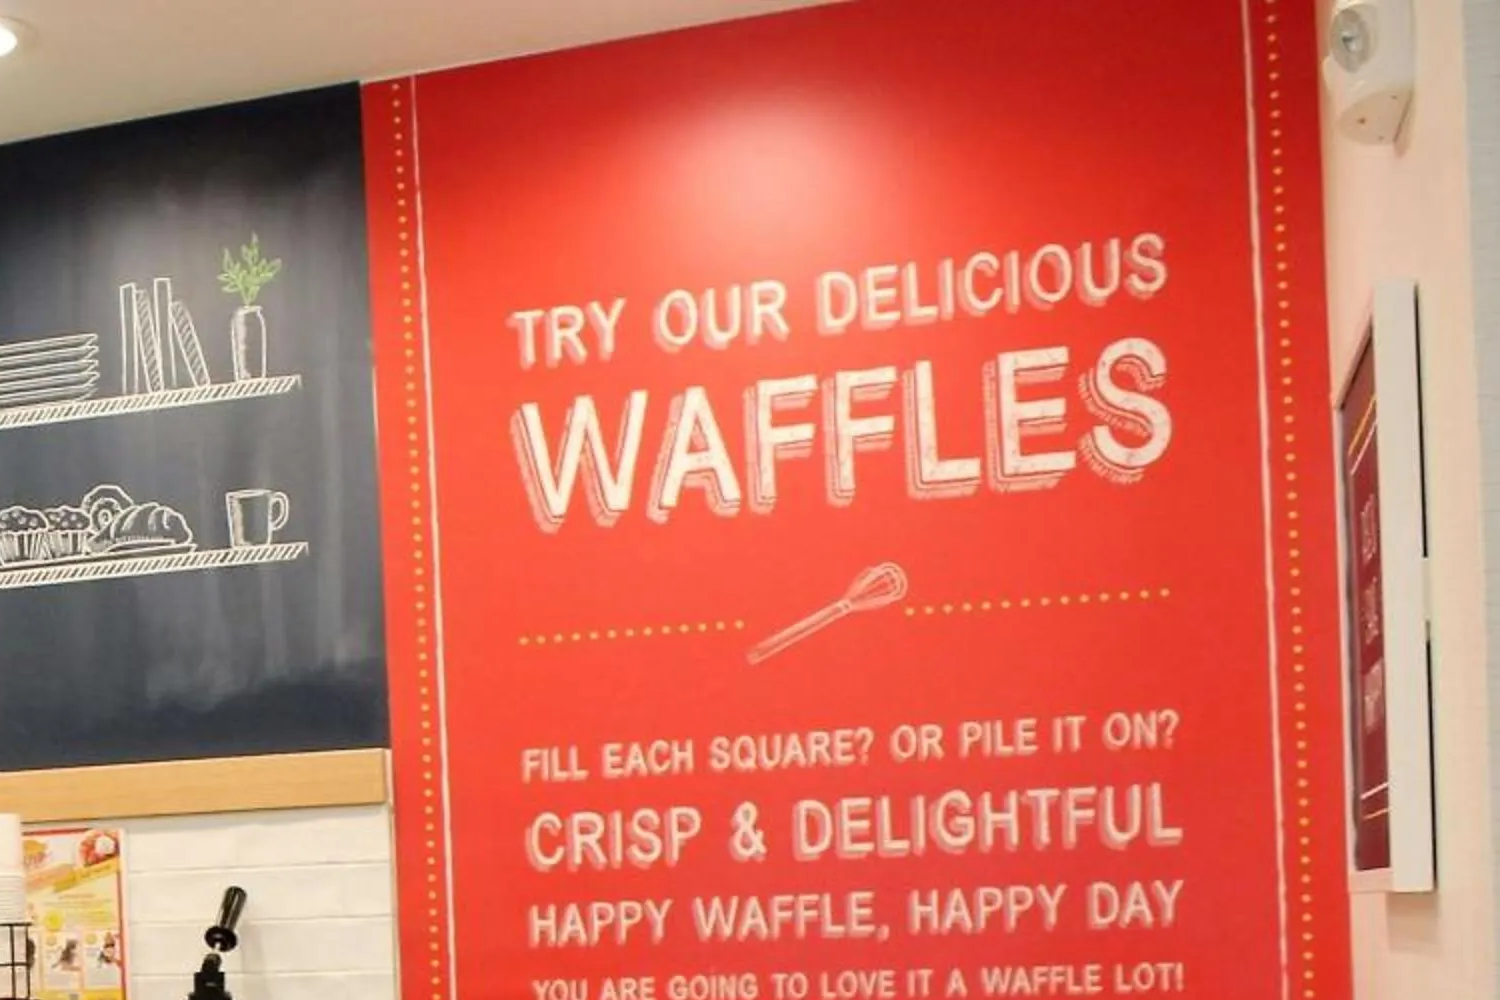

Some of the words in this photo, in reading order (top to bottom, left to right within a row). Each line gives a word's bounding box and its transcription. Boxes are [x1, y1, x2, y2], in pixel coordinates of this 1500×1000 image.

[506, 298, 625, 369] TRY
[654, 280, 789, 351] OUR
[816, 233, 1167, 334] DELICIOUS
[510, 337, 1173, 534] WAFFLES
[521, 748, 588, 783] FILL
[602, 740, 695, 777] EACH
[709, 727, 875, 772] SQUARE?
[889, 724, 944, 761] OR
[958, 718, 1038, 757] PILE
[1052, 715, 1086, 752] IT
[1102, 709, 1181, 749] ON?
[525, 807, 702, 871] CRISP
[729, 802, 768, 861] &
[793, 782, 1184, 860] DELIGHTFUL
[528, 899, 672, 947] HAPPY
[693, 892, 890, 941] WAFFLE,
[909, 883, 1067, 935] HAPPY
[1087, 879, 1185, 929] DAY
[772, 972, 809, 1000] TO
[820, 969, 896, 1000] LOVE
[907, 968, 933, 997] IT
[945, 968, 968, 996] A
[981, 963, 1104, 996] WAFFLE
[1114, 962, 1185, 992] LOT!
